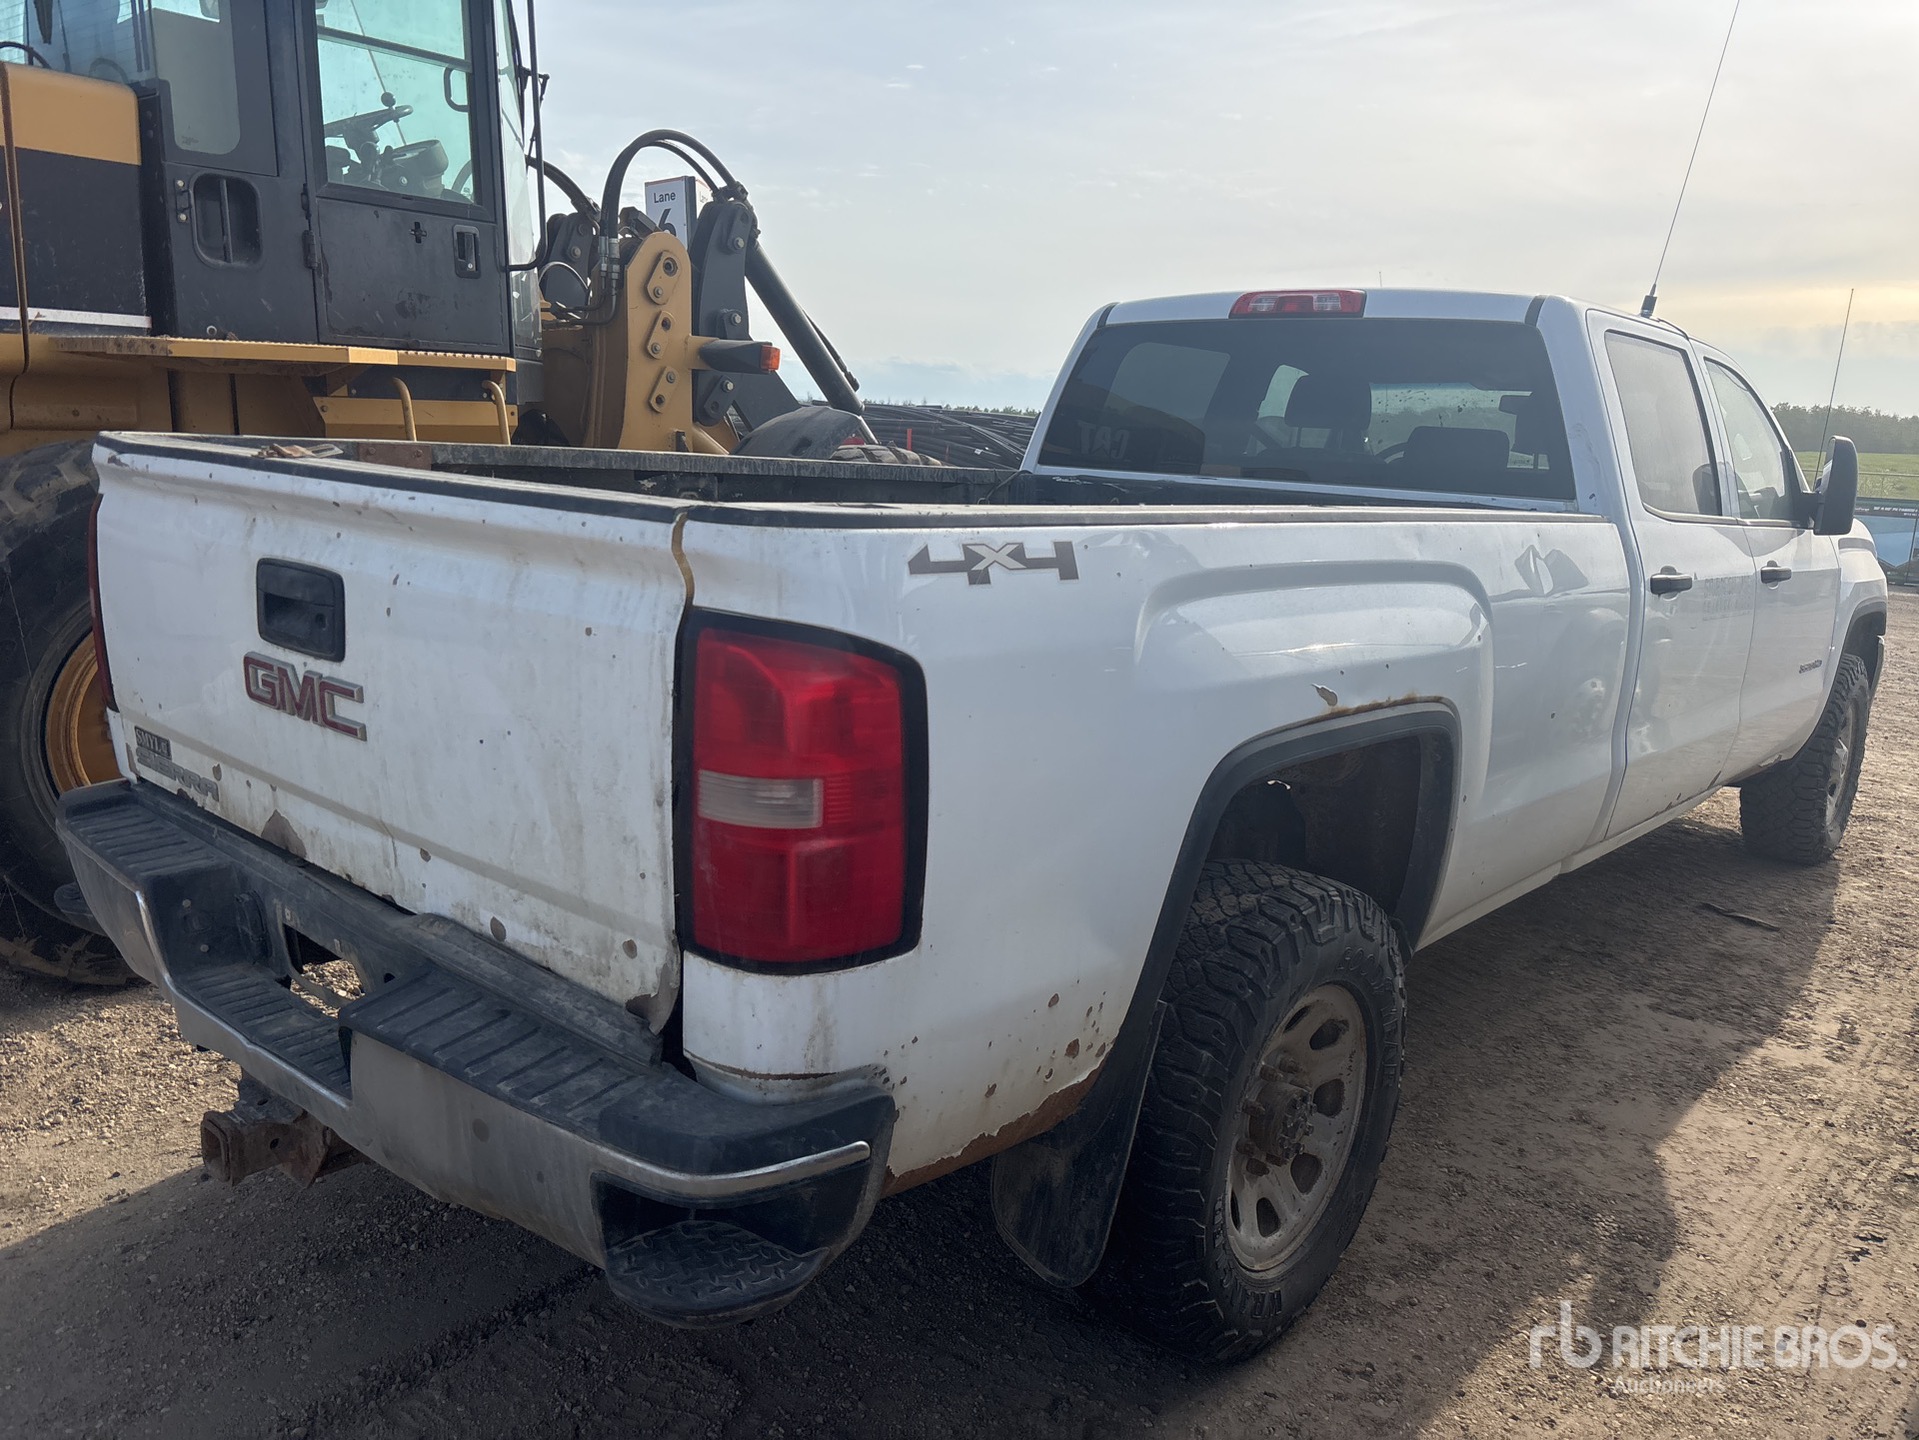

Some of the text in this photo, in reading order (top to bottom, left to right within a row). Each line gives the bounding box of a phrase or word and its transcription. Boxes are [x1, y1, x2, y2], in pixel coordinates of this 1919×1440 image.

[653, 191, 676, 204] Lane
[243, 651, 367, 742] GMC
[135, 746, 220, 803] SIERRA
